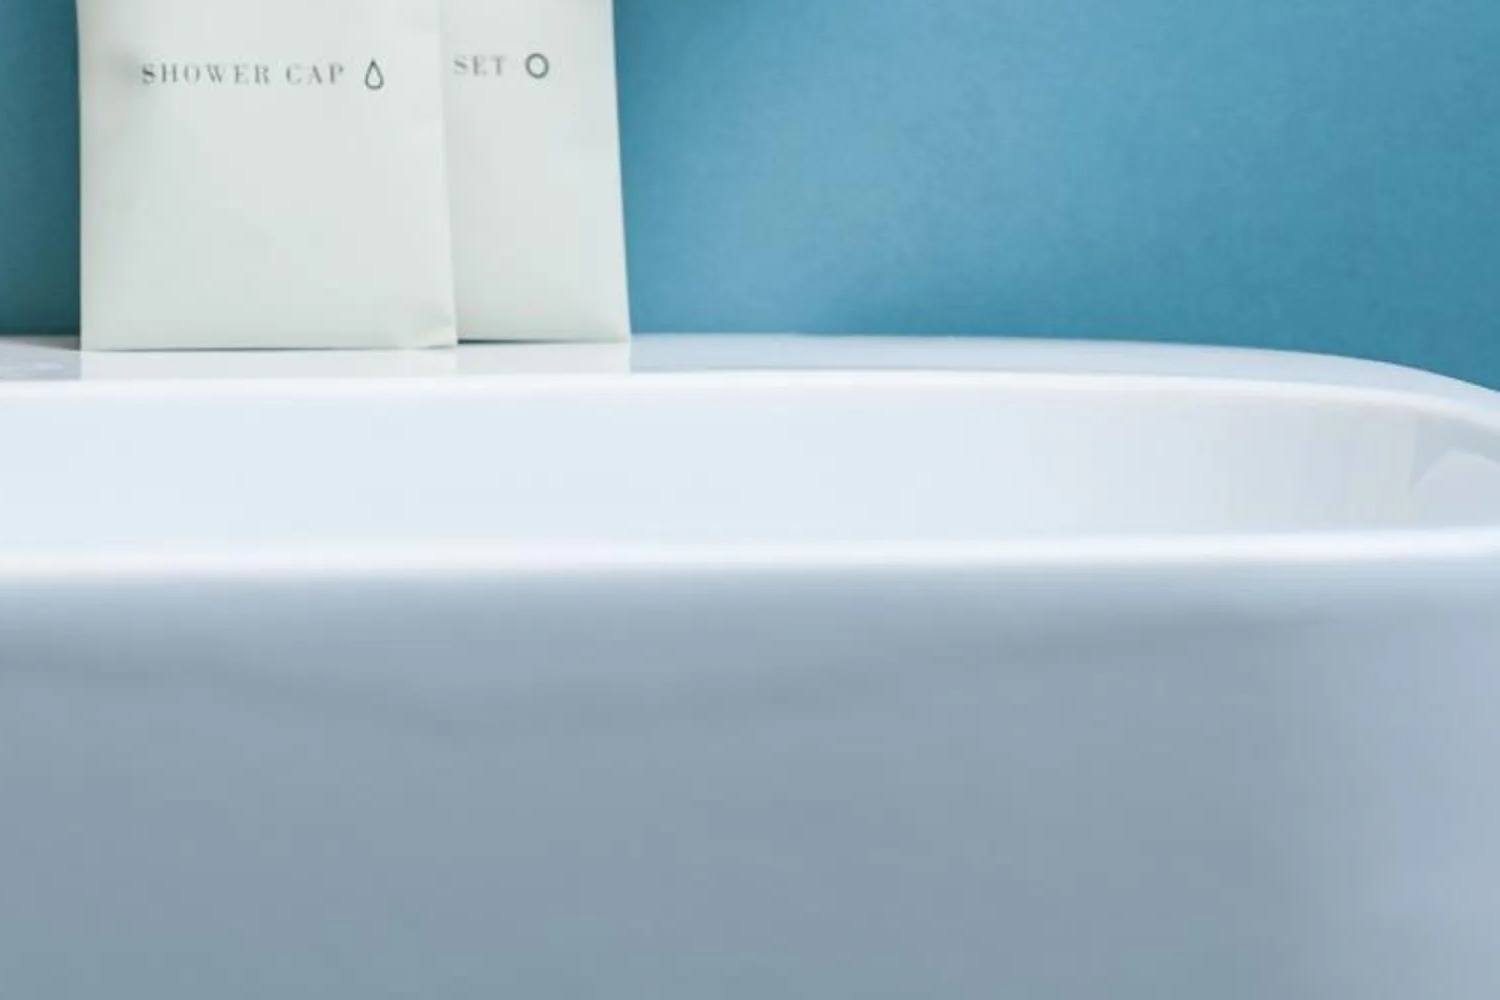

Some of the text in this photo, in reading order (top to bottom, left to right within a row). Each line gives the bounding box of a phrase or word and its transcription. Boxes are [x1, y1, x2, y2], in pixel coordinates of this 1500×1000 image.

[141, 63, 344, 85] SHOWER CAP
[453, 55, 506, 77] SET
